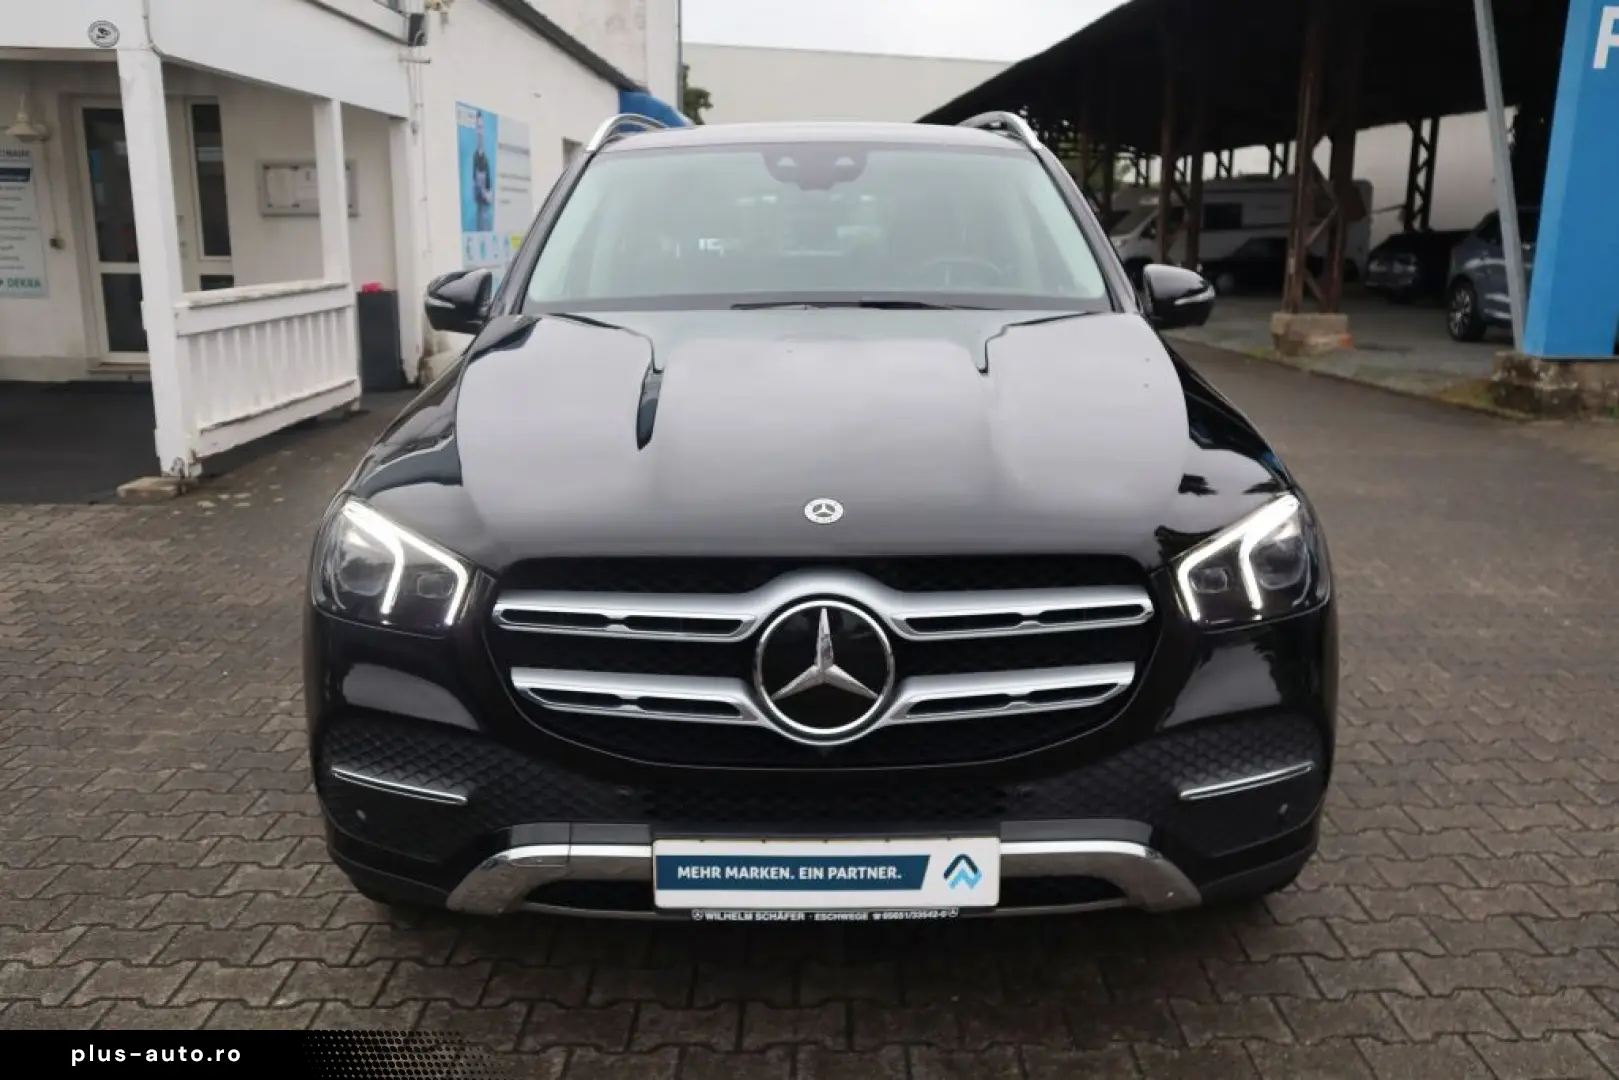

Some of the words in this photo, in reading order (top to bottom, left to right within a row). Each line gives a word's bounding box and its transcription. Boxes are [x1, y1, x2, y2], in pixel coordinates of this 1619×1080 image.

[677, 864, 721, 879] MEHR
[725, 864, 795, 879] MARKEN.
[799, 864, 824, 879] EIN
[828, 864, 902, 879] PARTNER.
[704, 911, 753, 921] WILHELM
[814, 912, 869, 921] ESCHWEGE
